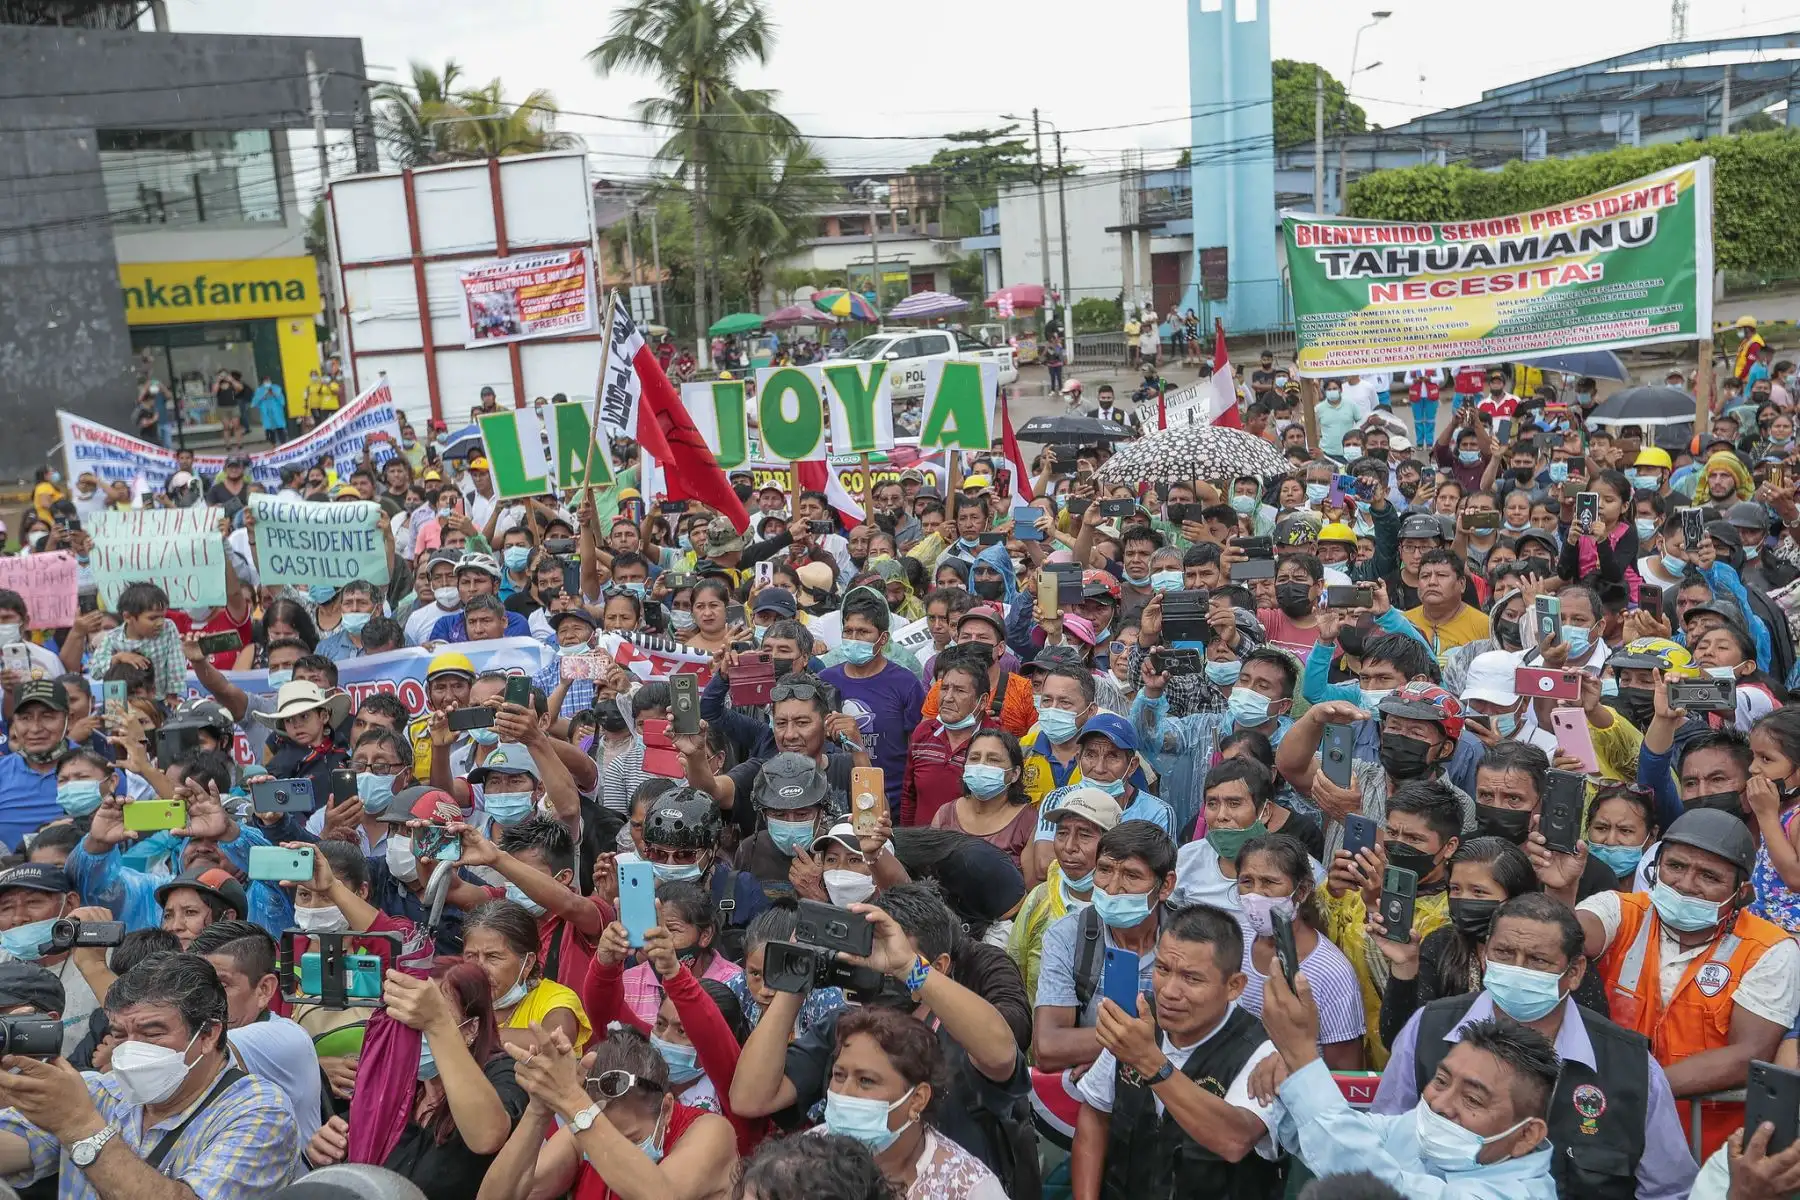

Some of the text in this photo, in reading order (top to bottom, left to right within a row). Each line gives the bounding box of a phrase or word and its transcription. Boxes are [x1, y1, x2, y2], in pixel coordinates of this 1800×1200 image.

[1296, 224, 1433, 247] BIENVENIDO
[1531, 181, 1678, 233] PRESIDENTE
[1320, 215, 1657, 277] TAHUAMANU
[515, 256, 565, 271] LIBRE
[1369, 264, 1603, 304] NECESITA:
[1302, 323, 1316, 331] SAN
[1361, 319, 1390, 327] PORRES
[1361, 307, 1400, 318] INMEDIATA
[1321, 338, 1366, 347] EXPEDIENTE
[1403, 332, 1449, 342] HABILITADO
[1361, 326, 1401, 336] INMEDIATA
[1373, 345, 1416, 355] CONSEJO
[1418, 343, 1427, 351] DE
[1432, 340, 1482, 351] MINISTROS
[1484, 328, 1571, 346] DESCENTRALIZADO
[1572, 326, 1587, 335] EN
[1384, 354, 1416, 363] MESAS
[1464, 347, 1489, 356] PARA
[1491, 340, 1549, 353] SOLUCIONAR
[478, 401, 614, 499] LA
[258, 500, 369, 525] BIENVENIDO
[266, 526, 377, 553] PRESIDENTE
[269, 554, 360, 579] CASTILLO
